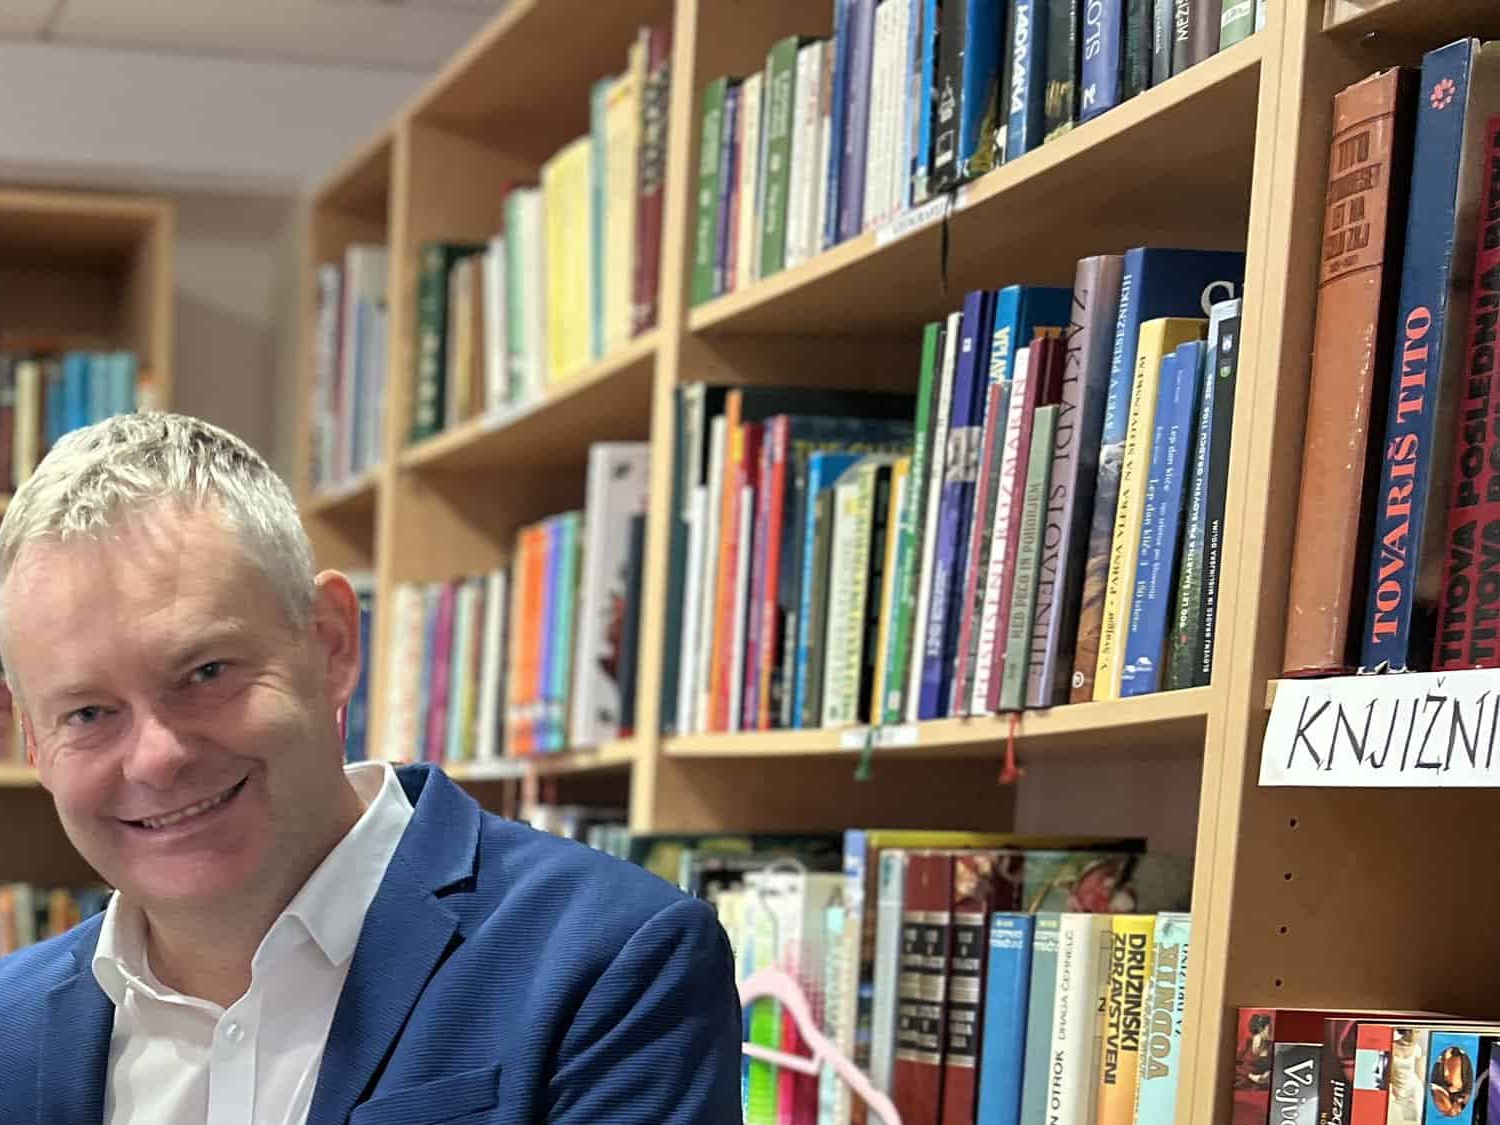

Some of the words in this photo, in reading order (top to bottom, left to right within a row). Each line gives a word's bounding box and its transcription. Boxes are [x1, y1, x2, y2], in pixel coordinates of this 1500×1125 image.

[1371, 432, 1419, 645] TOVARIŠ
[1396, 305, 1432, 424] TITO
[1439, 519, 1477, 666] TITOVA
[1049, 1050, 1065, 1111] OTROK
[1103, 932, 1127, 1085] ZDRAVSTVENI
[1146, 943, 1178, 1080] VODNIK
